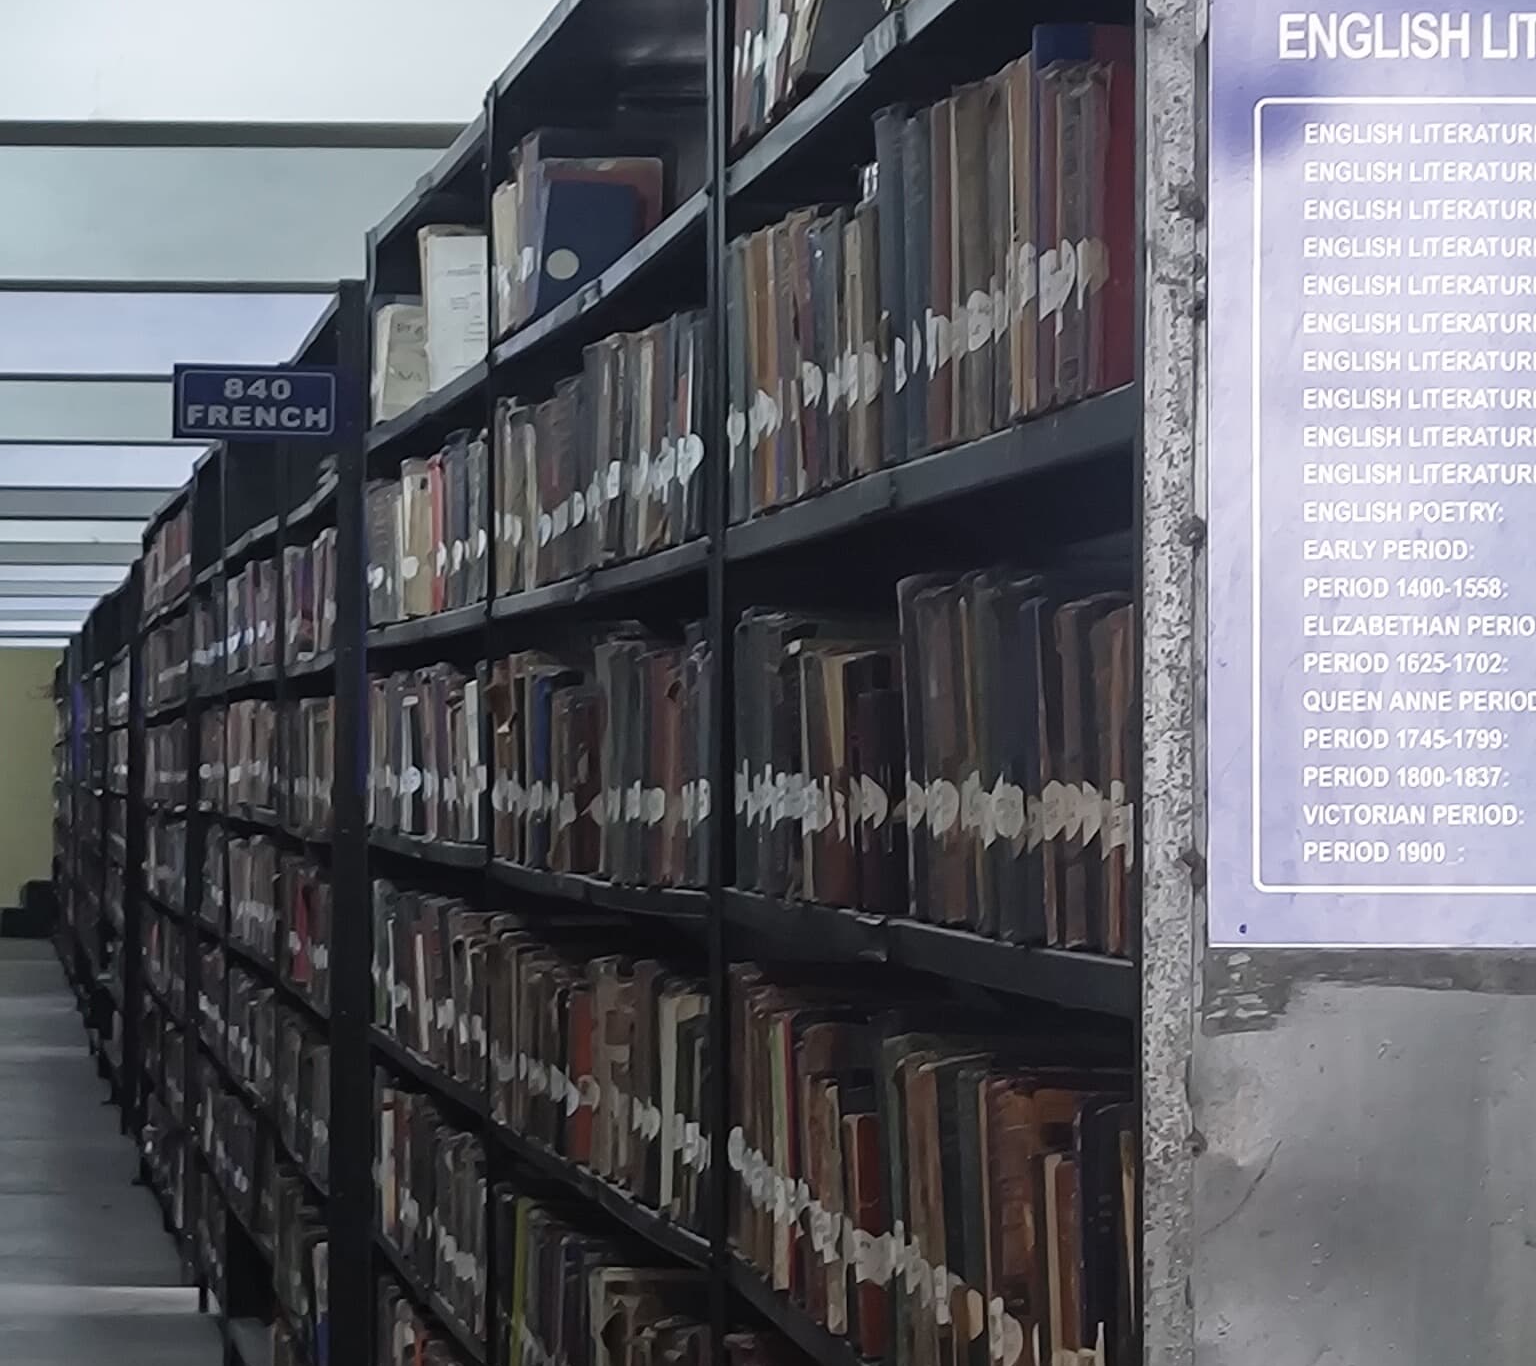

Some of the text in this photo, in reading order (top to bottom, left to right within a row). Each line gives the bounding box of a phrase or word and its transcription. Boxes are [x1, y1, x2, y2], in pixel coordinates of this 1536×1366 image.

[1279, 13, 1470, 59] ENGLISH
[1304, 122, 1536, 145] ENGLISH LITERATUR
[1304, 161, 1536, 183] ENGLISH LITERATUR
[1304, 199, 1536, 220] ENGLISH LITERATUR
[1304, 236, 1536, 258] ENGLISH LITERATUR
[1304, 274, 1536, 296] ENGLISH LITERATUR
[1304, 312, 1536, 334] ENGLISH LITERATUR
[1304, 350, 1536, 372] ENGLISH LITERATUR
[224, 378, 291, 400] 840
[1304, 388, 1536, 410] ENGLISH LITERATUR
[187, 405, 327, 429] FRENCH
[1304, 426, 1536, 448] ENGLISH LITERATUR
[1304, 463, 1536, 485] ENGLISH LITERATUR
[1303, 501, 1505, 523] ENGLISH POETRY:
[1303, 539, 1475, 560] EARLY PERIOD:
[1303, 577, 1509, 599] PERIOD 1400-1558:
[1303, 615, 1460, 636] ELIZABETHAN
[1303, 652, 1509, 674] PERIOD 1625-1702:
[1303, 690, 1383, 712] QUEEN
[1388, 690, 1453, 712] ANNE
[1303, 728, 1509, 749] PERIOD 1745-1799:
[1303, 766, 1510, 788] PERIOD 1800-1837:
[1303, 804, 1525, 826] VICTORIAN PERIOD:
[1303, 841, 1390, 863] PERIOD
